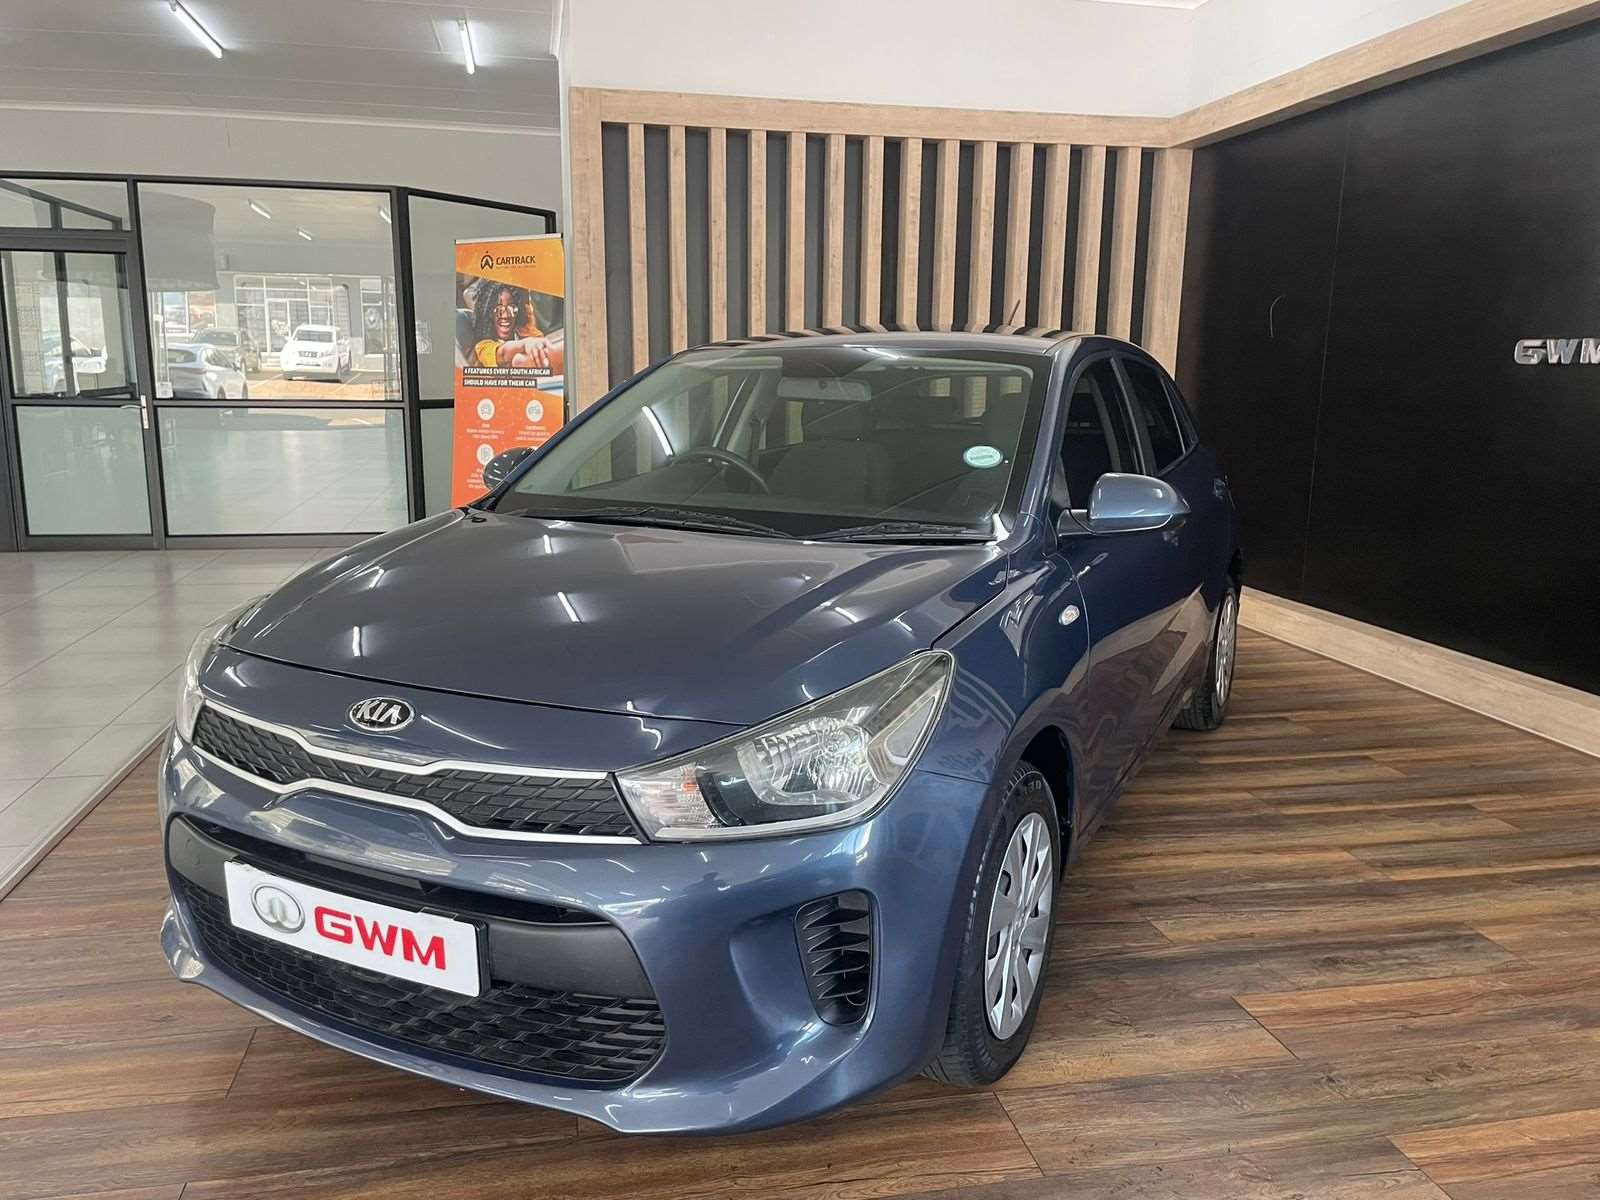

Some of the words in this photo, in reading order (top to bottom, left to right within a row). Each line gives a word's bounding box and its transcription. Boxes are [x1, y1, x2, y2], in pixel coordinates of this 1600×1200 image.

[496, 255, 536, 265] CARTRACK
[356, 698, 402, 725] KIA
[314, 905, 447, 970] GWM
